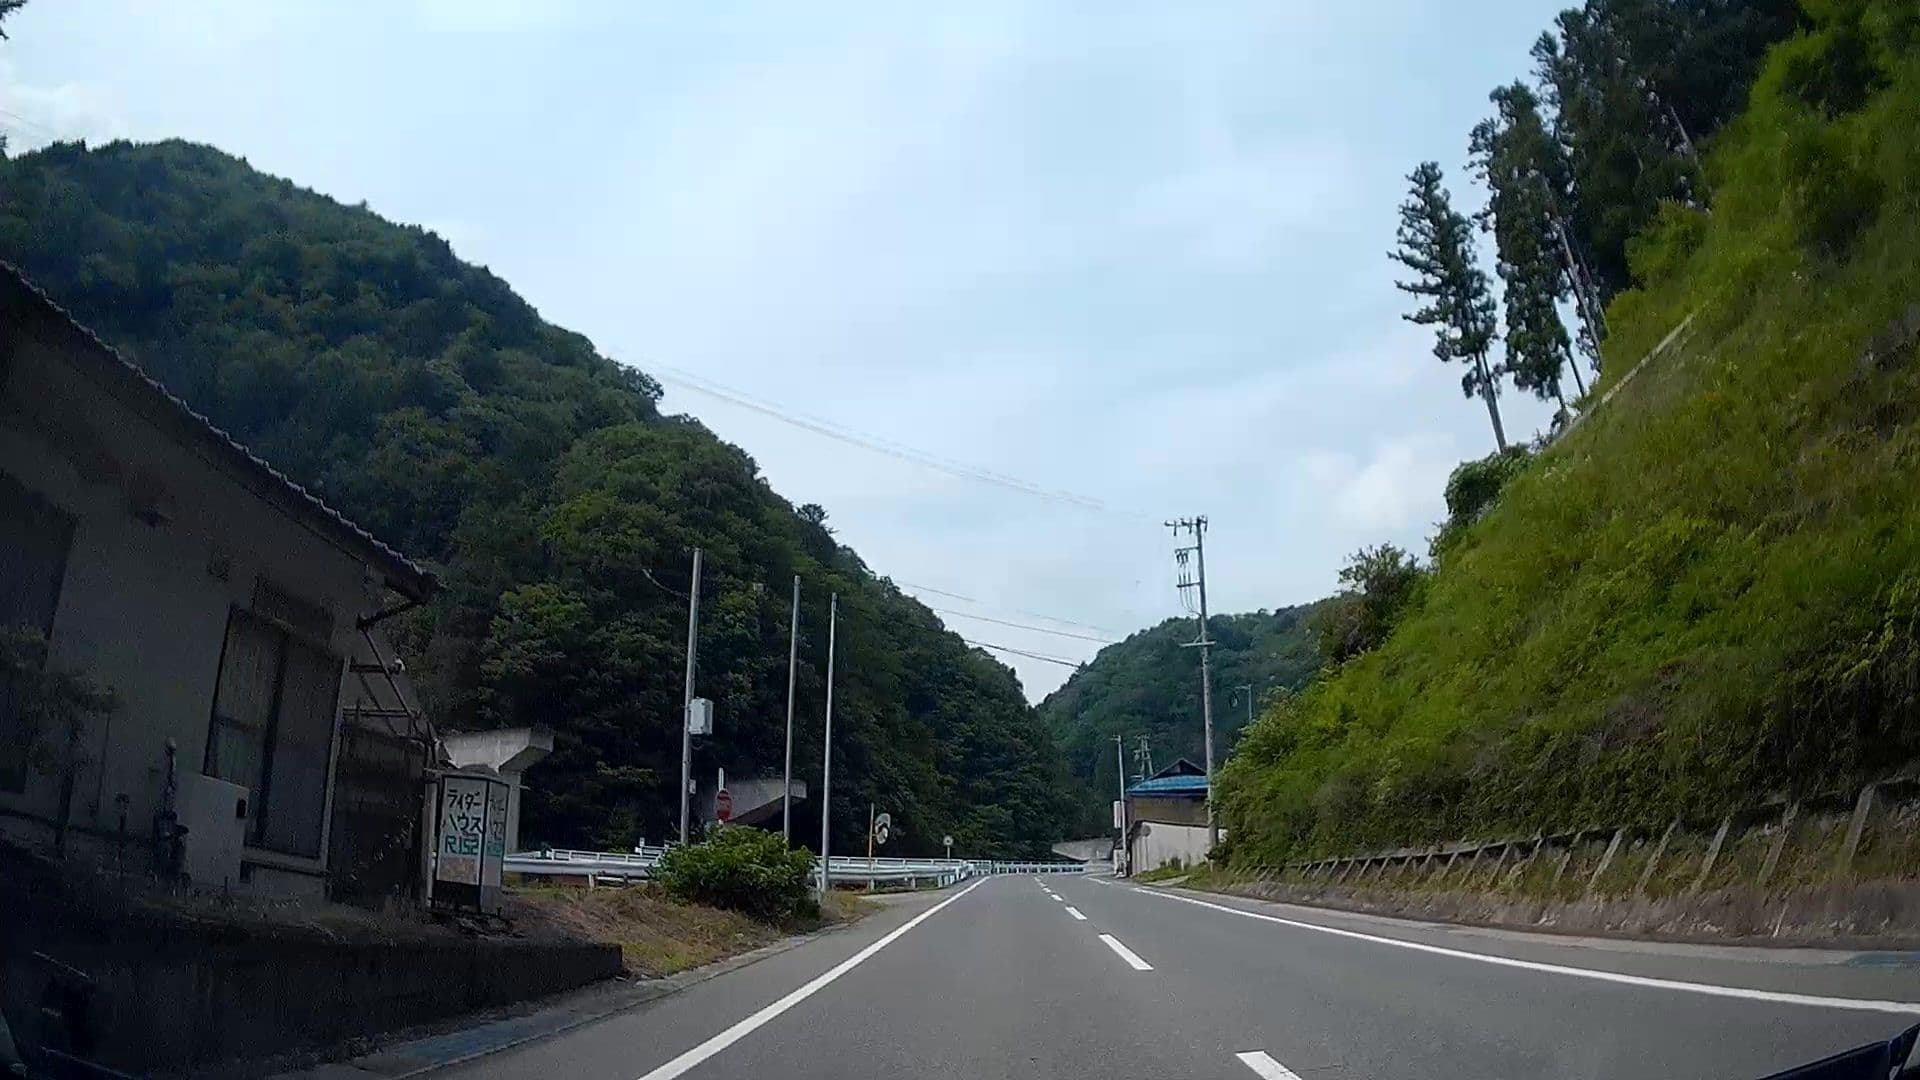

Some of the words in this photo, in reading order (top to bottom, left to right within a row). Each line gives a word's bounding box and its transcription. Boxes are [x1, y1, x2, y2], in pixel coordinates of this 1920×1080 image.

[447, 789, 481, 810] ライダー
[442, 813, 482, 834] ハウス
